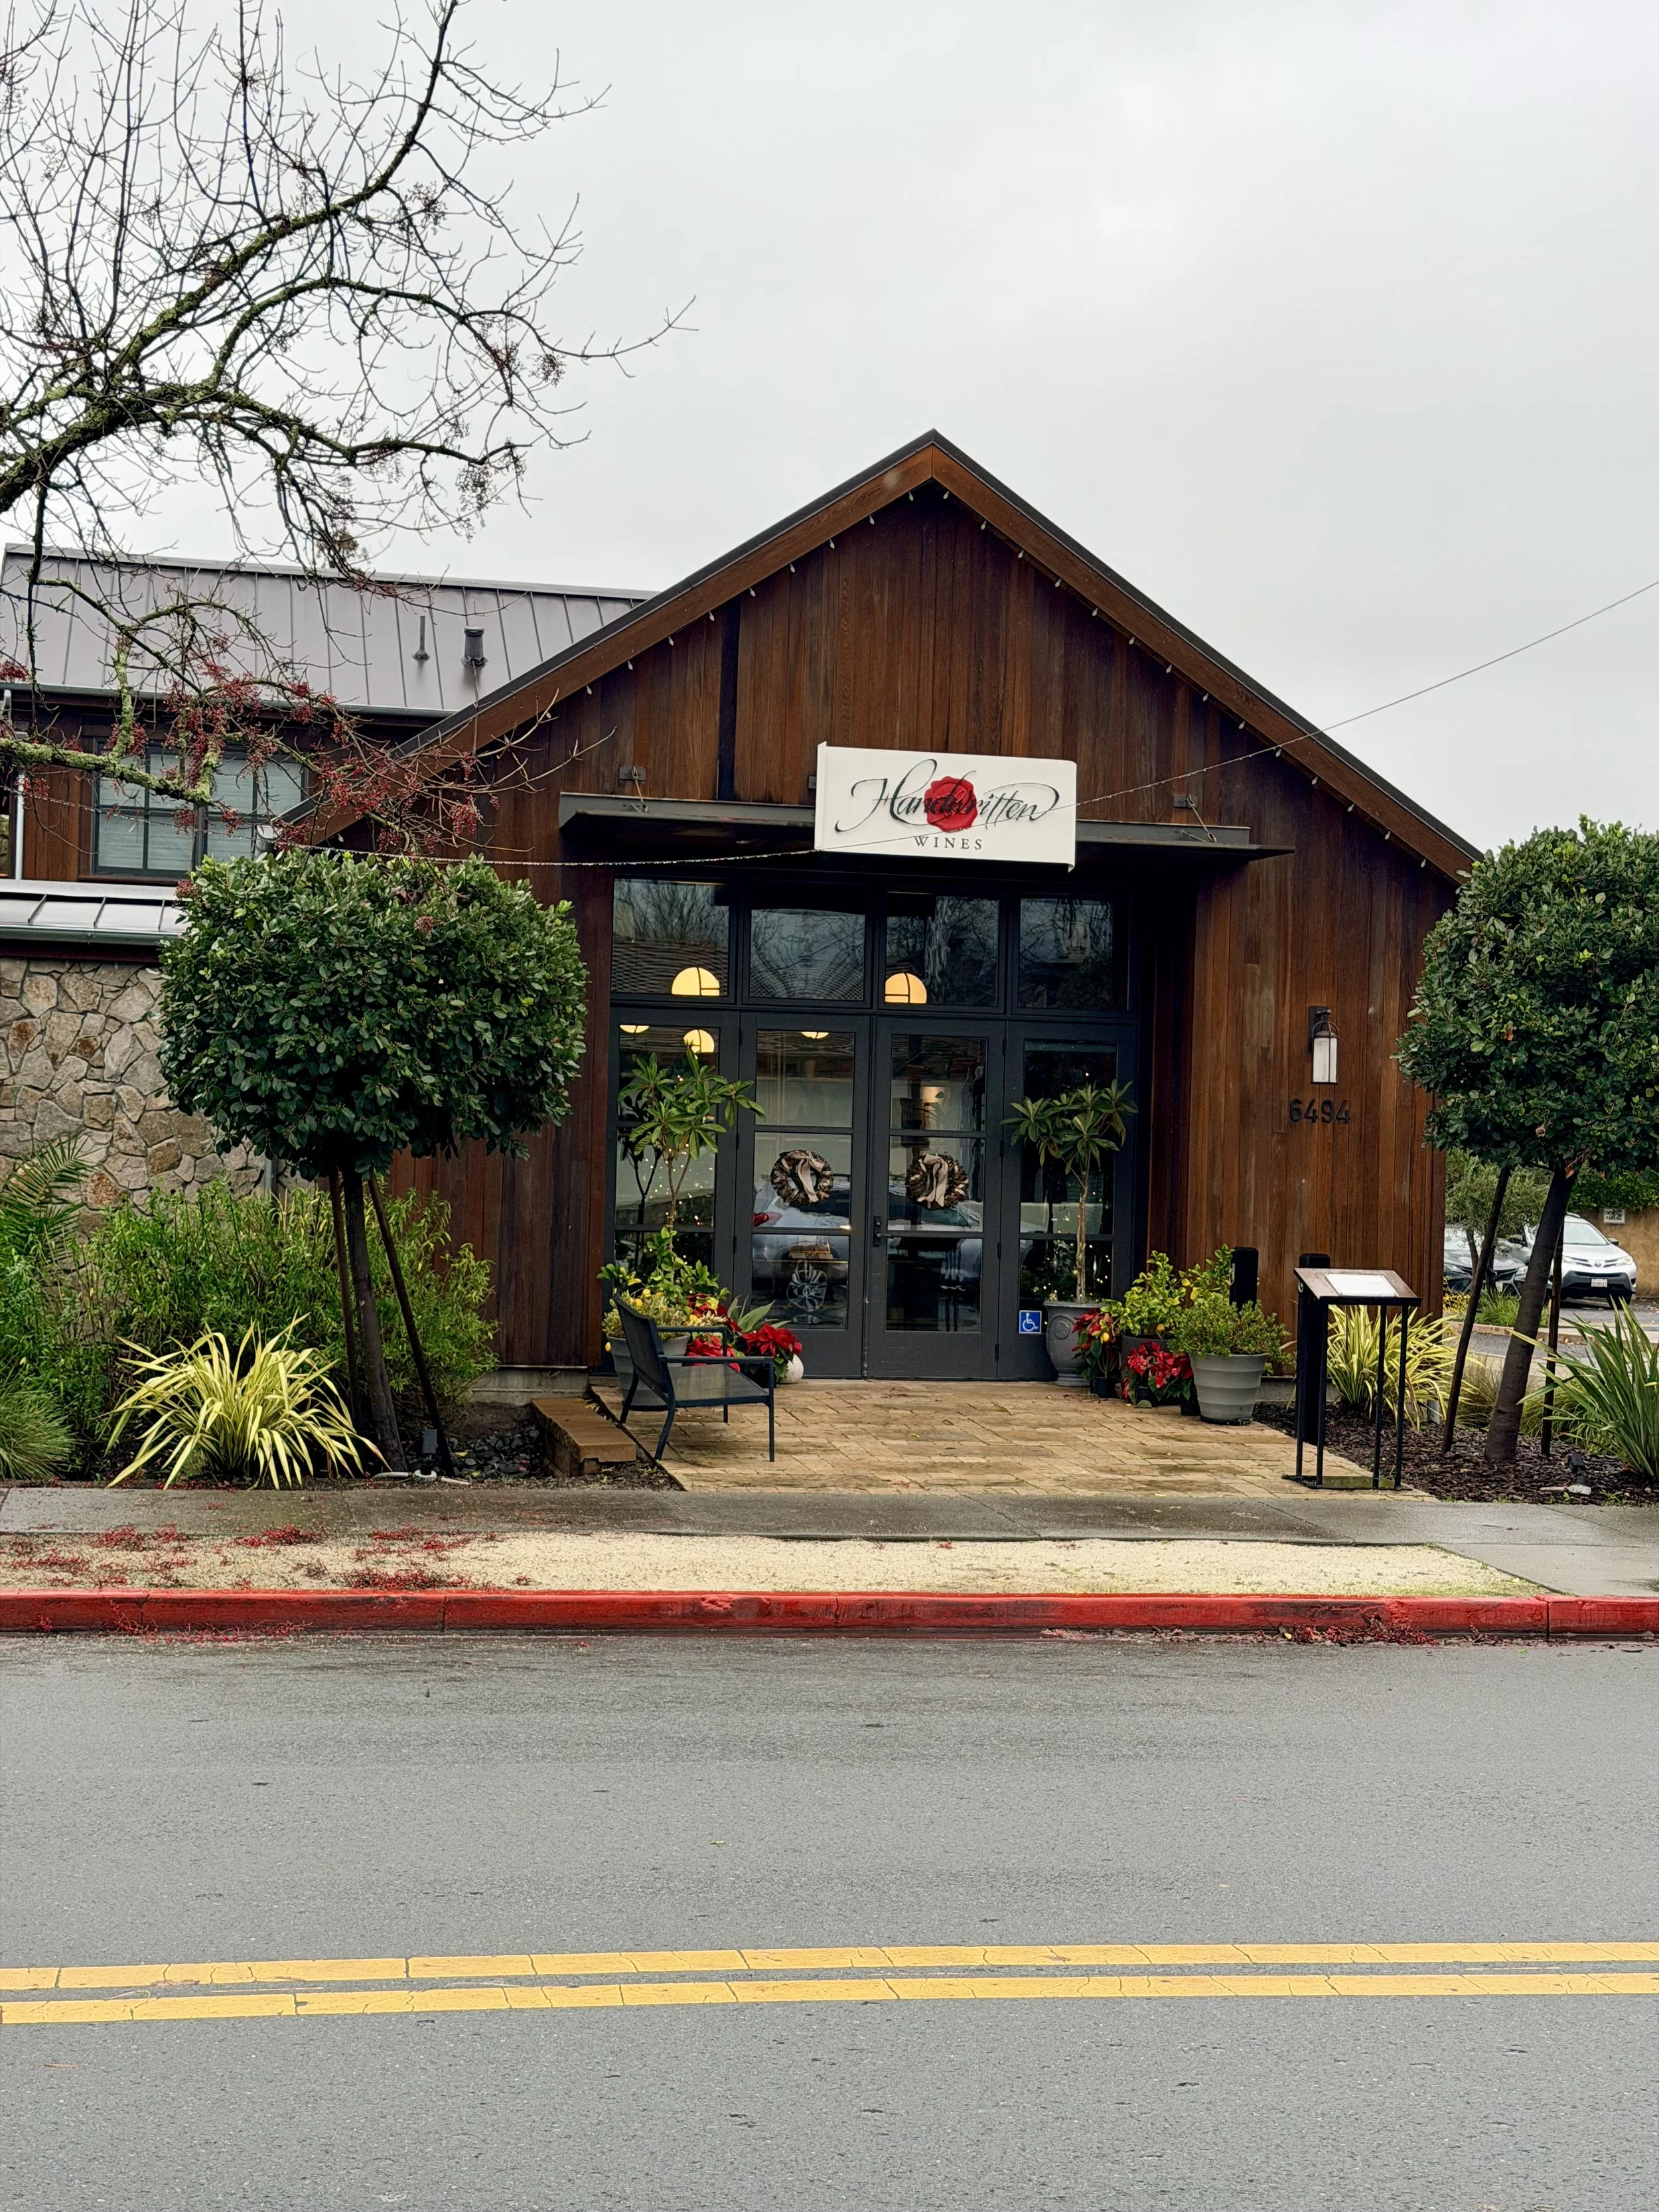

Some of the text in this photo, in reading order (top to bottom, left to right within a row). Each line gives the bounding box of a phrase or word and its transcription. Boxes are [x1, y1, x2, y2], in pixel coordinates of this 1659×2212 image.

[834, 758, 1060, 832] Handwritten
[914, 836, 983, 850] WINES
[1289, 1098, 1351, 1124] 6494
